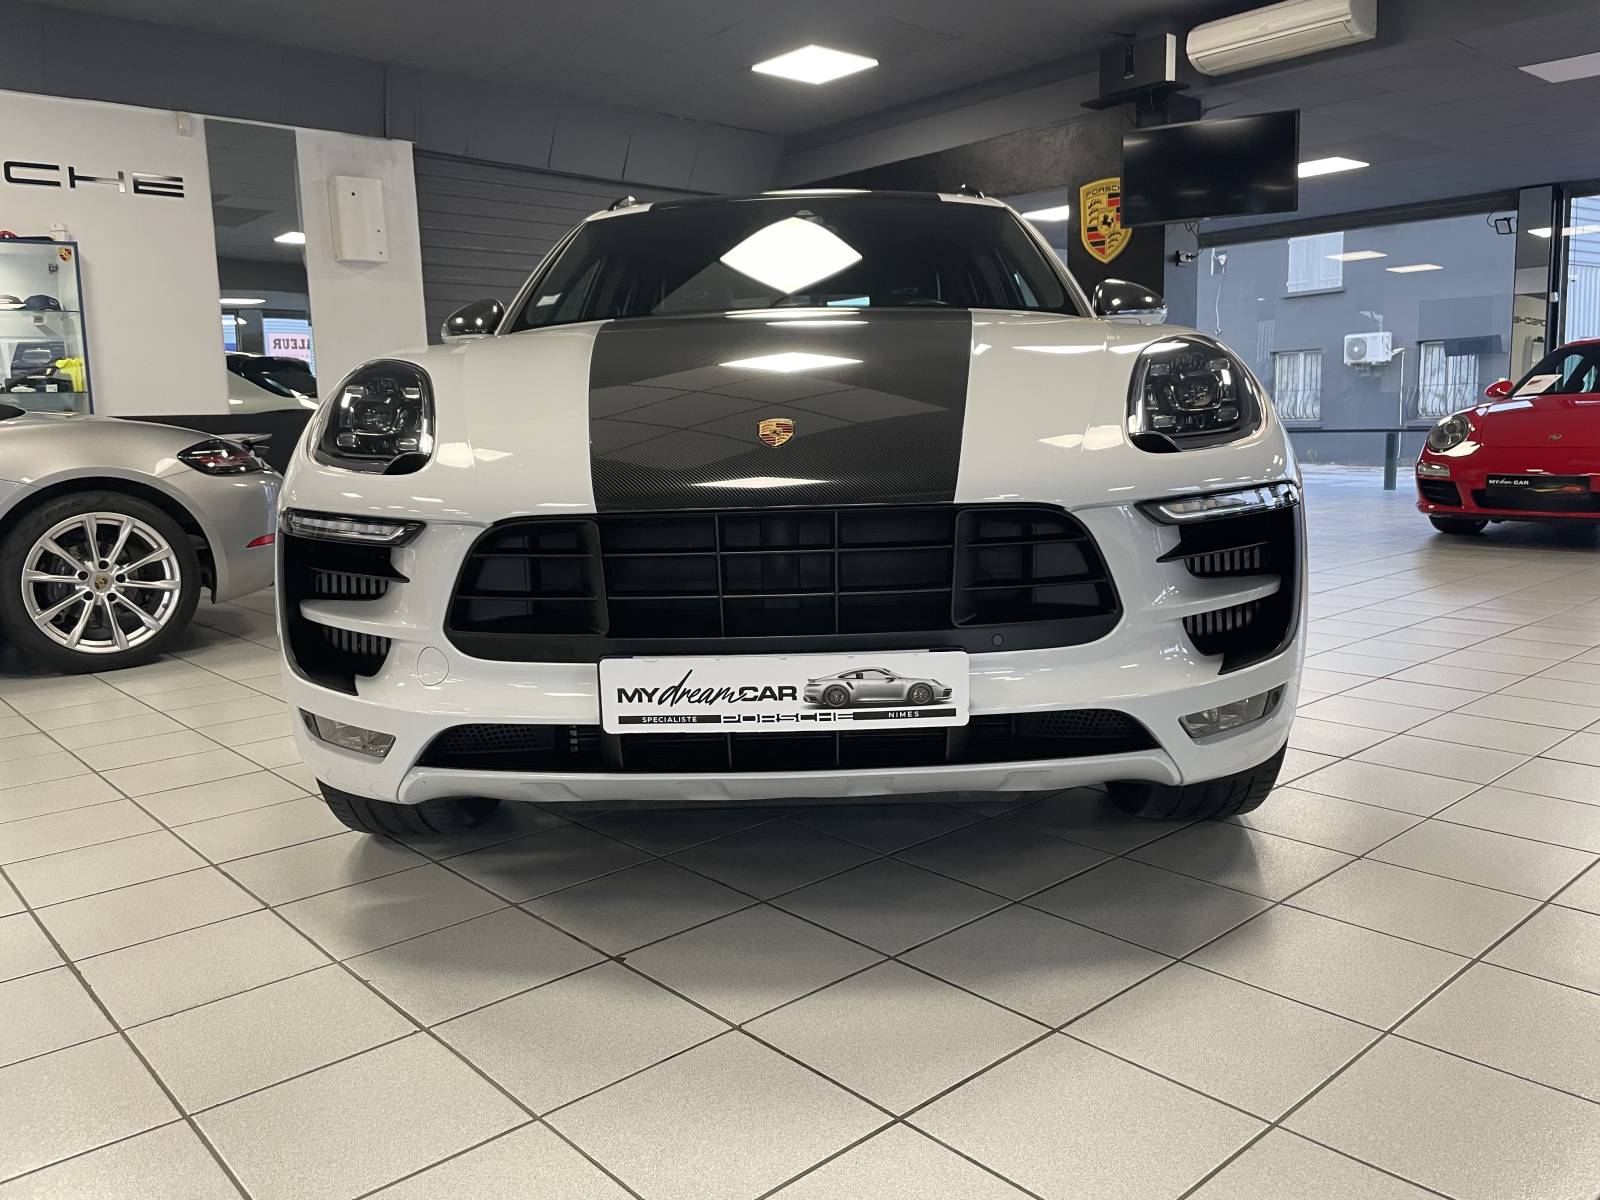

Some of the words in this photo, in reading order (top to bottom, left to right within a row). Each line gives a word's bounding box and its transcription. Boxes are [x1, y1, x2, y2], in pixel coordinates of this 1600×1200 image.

[3, 160, 185, 198] CHE
[617, 688, 660, 703] MY
[658, 669, 747, 706] dream
[739, 686, 798, 702] CAR
[720, 711, 854, 724] PORSCHE
